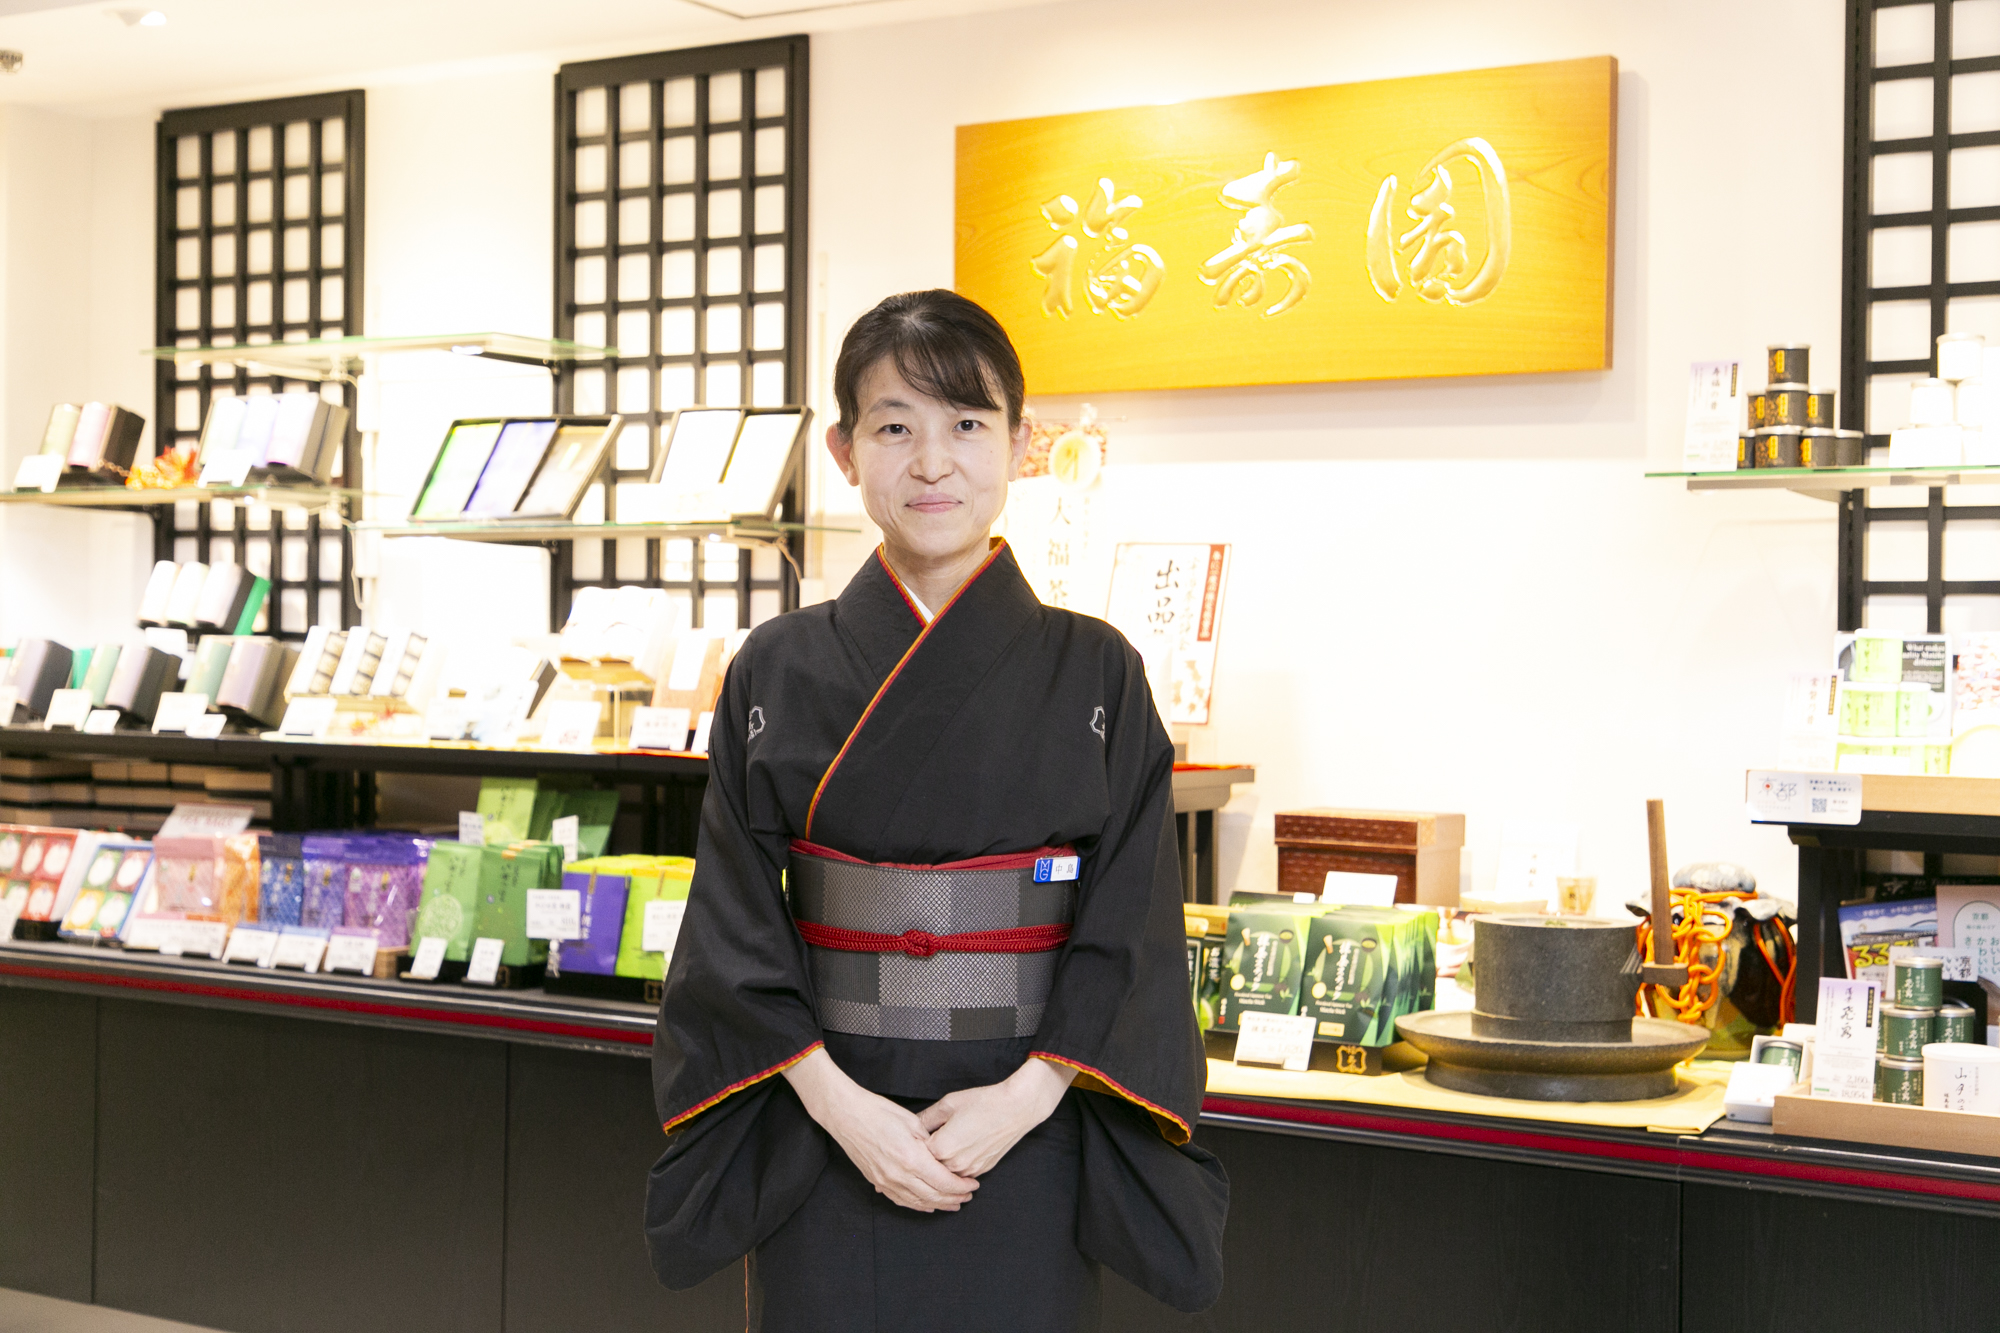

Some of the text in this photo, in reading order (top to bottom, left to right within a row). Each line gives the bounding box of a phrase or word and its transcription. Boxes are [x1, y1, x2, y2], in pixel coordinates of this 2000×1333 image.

[1030, 136, 1511, 320] 福寿園
[1147, 559, 1180, 635] 出品
[1976, 936, 1988, 975] かわいい
